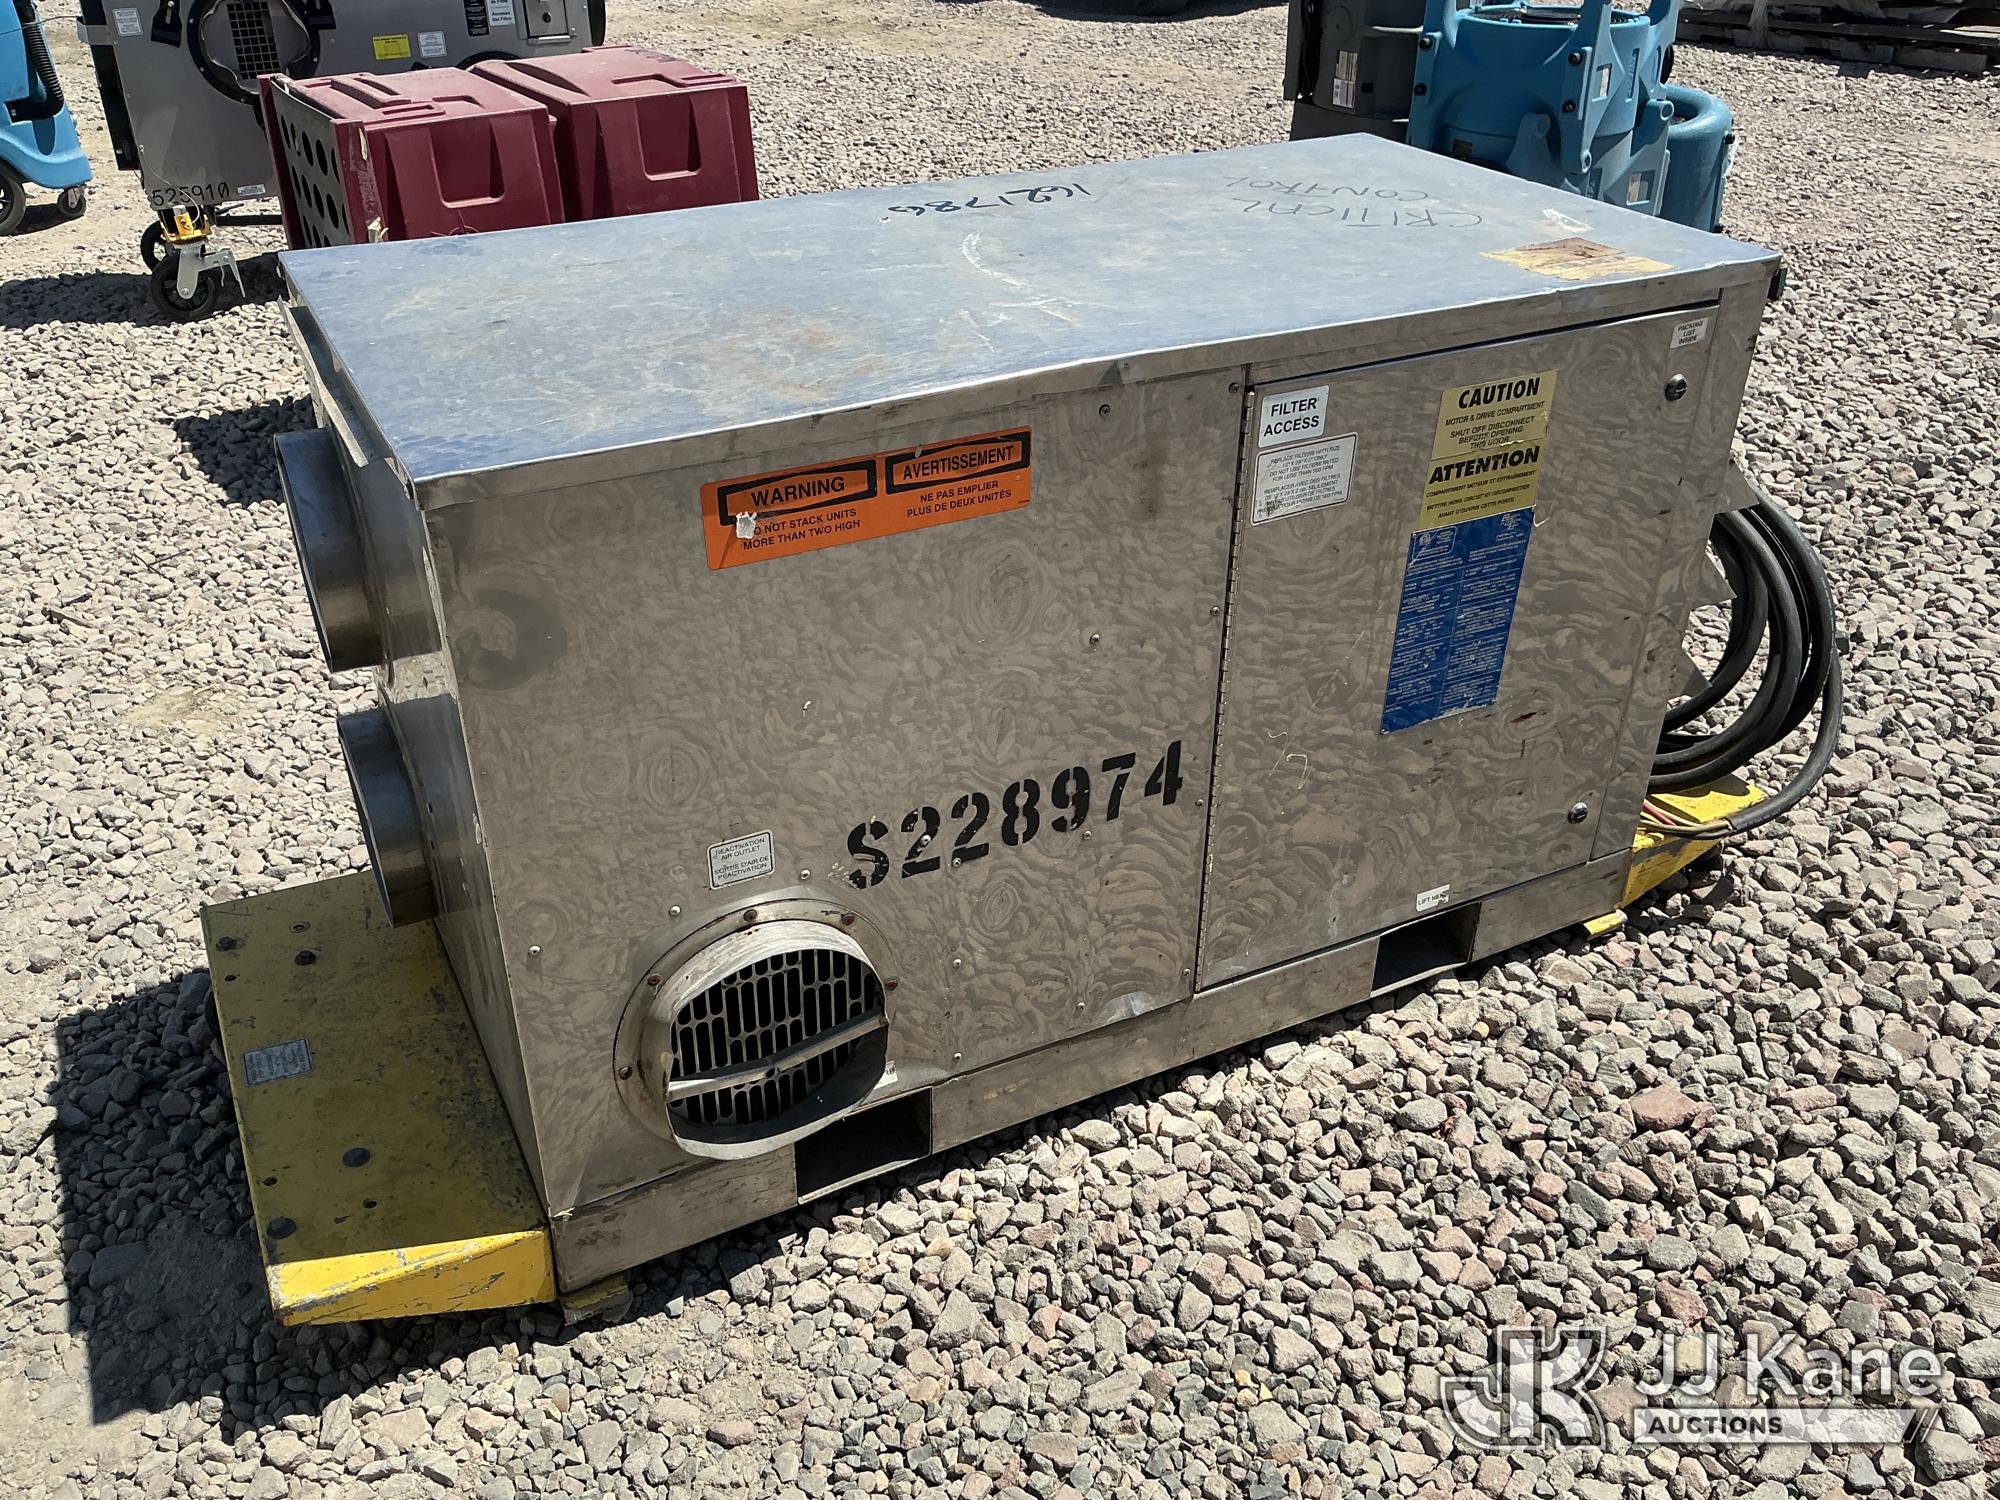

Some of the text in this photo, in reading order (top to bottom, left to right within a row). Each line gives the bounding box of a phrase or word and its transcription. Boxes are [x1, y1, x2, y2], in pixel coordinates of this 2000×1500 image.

[1224, 176, 1429, 201] CONTROL
[1233, 197, 1482, 228] CRITICAL
[1678, 320, 1703, 332] PACKING
[1683, 329, 1696, 337] LIST
[1679, 335, 1697, 344] INSIDE
[1458, 378, 1540, 409] CAUTION
[1271, 397, 1317, 417] FILTER
[1445, 415, 1469, 426] MOTOR
[1475, 410, 1496, 420] DRIVE
[1497, 401, 1545, 416] COMPARTMENT
[1264, 416, 1319, 436] ACCESS
[1449, 416, 1535, 439] SHUT OFF DISCONNECT
[1459, 426, 1524, 444] BEFORE OPENING
[1470, 441, 1486, 450] THIS
[903, 445, 1015, 481] AVERTISSEMENT
[1429, 446, 1540, 484] ATTENTION
[751, 476, 845, 507] WARNING
[907, 489, 1011, 517] PLUS DE DEUX UNITÉS
[920, 481, 998, 503] NE PAS EMPLIER
[765, 522, 786, 533] NOT
[790, 515, 824, 528] STACK
[826, 508, 857, 521] UNITS
[743, 520, 861, 550] MORE THAN TWO HIGH
[847, 740, 1183, 890] S228974
[721, 845, 760, 861] AIR OUTLET
[1418, 897, 1430, 905] LIFT
